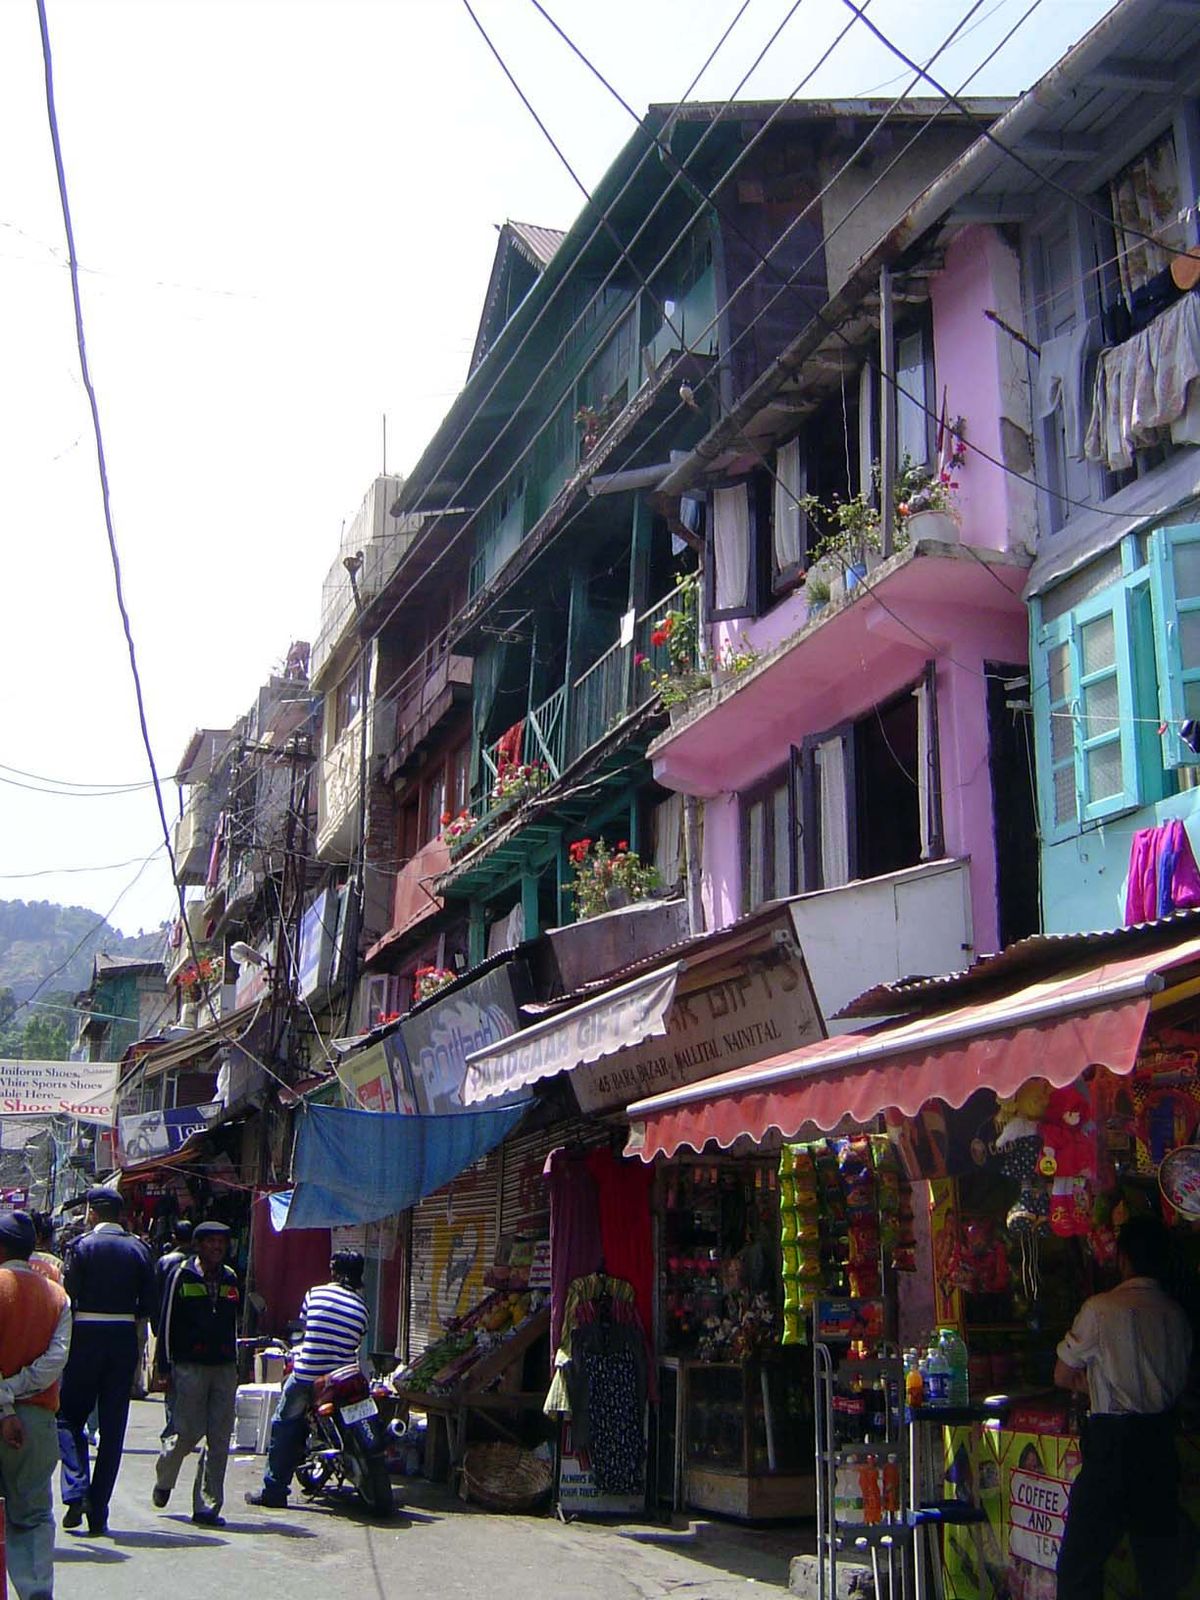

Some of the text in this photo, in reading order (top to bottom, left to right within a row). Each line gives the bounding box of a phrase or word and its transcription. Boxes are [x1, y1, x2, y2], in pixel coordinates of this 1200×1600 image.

[32, 1079, 67, 1091] Sports
[70, 1080, 102, 1090] Shoes
[4, 1098, 52, 1113] Shoe
[1018, 1484, 1059, 1512] COFFEE
[1028, 1512, 1052, 1533] AND
[1036, 1535, 1060, 1556] TEA
